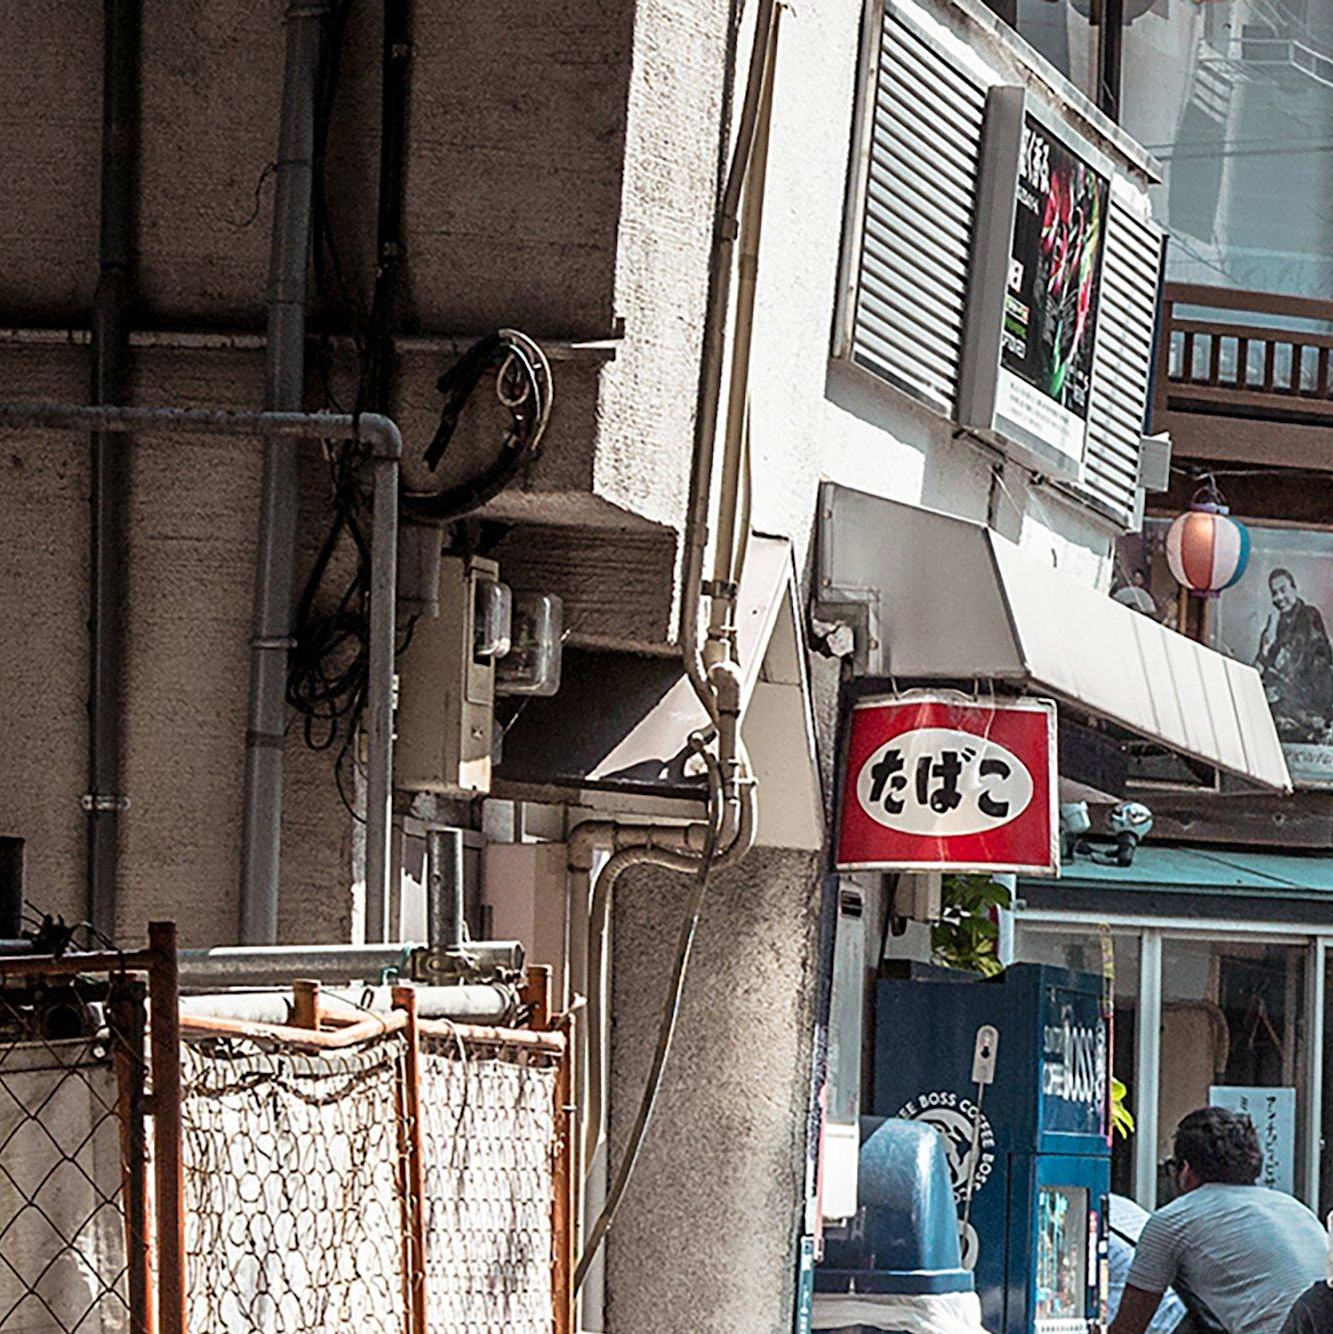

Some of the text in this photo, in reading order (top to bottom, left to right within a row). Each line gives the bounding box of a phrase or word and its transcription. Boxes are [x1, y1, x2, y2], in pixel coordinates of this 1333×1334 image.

[869, 747, 1011, 818] たばこ
[918, 1092, 957, 1108] BOSS
